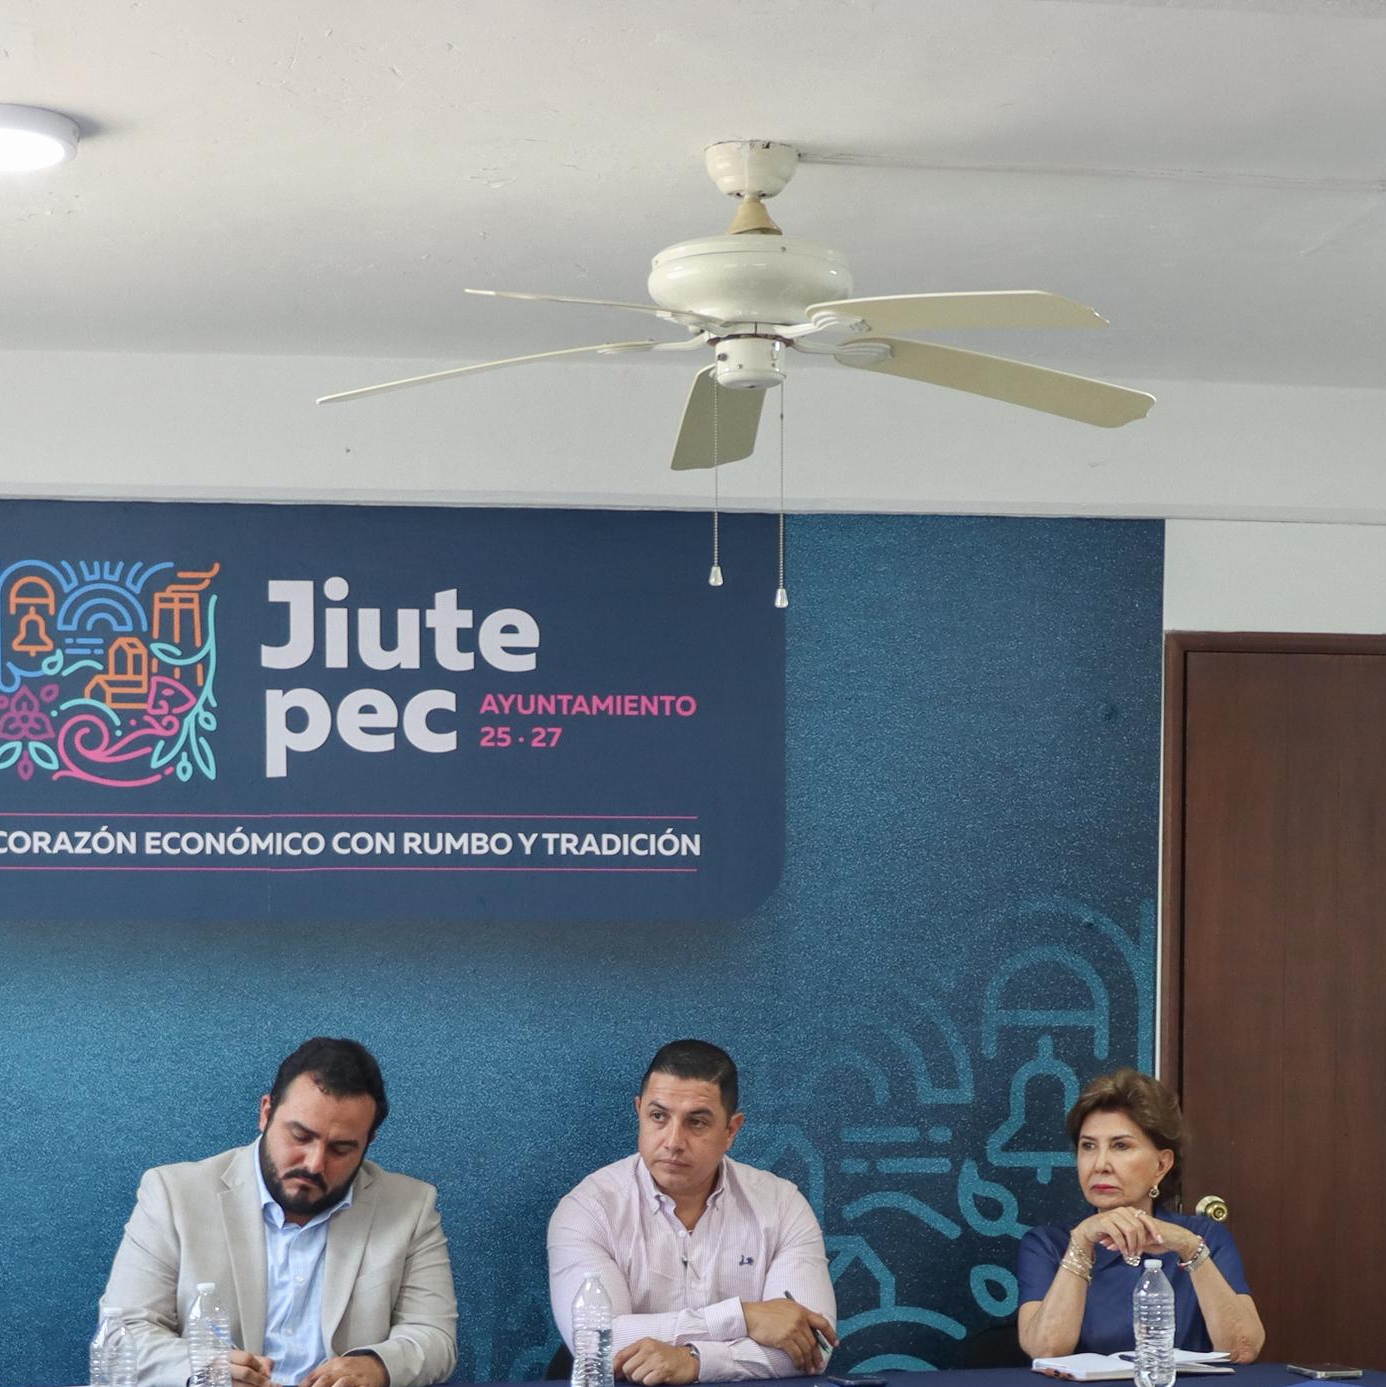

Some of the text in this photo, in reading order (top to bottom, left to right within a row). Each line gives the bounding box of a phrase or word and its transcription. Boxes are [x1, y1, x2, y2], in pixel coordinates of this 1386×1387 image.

[260, 576, 540, 672] Jiute
[480, 693, 697, 717] AYUNTAMIENTO
[265, 687, 457, 778] pec
[480, 726, 512, 747] 25
[531, 727, 562, 748] 27
[144, 824, 326, 856] ECONÓMICO
[331, 831, 395, 856] CON
[403, 831, 513, 856] RUMBO
[518, 832, 538, 856] Y
[542, 827, 701, 856] TRADICIÓN
